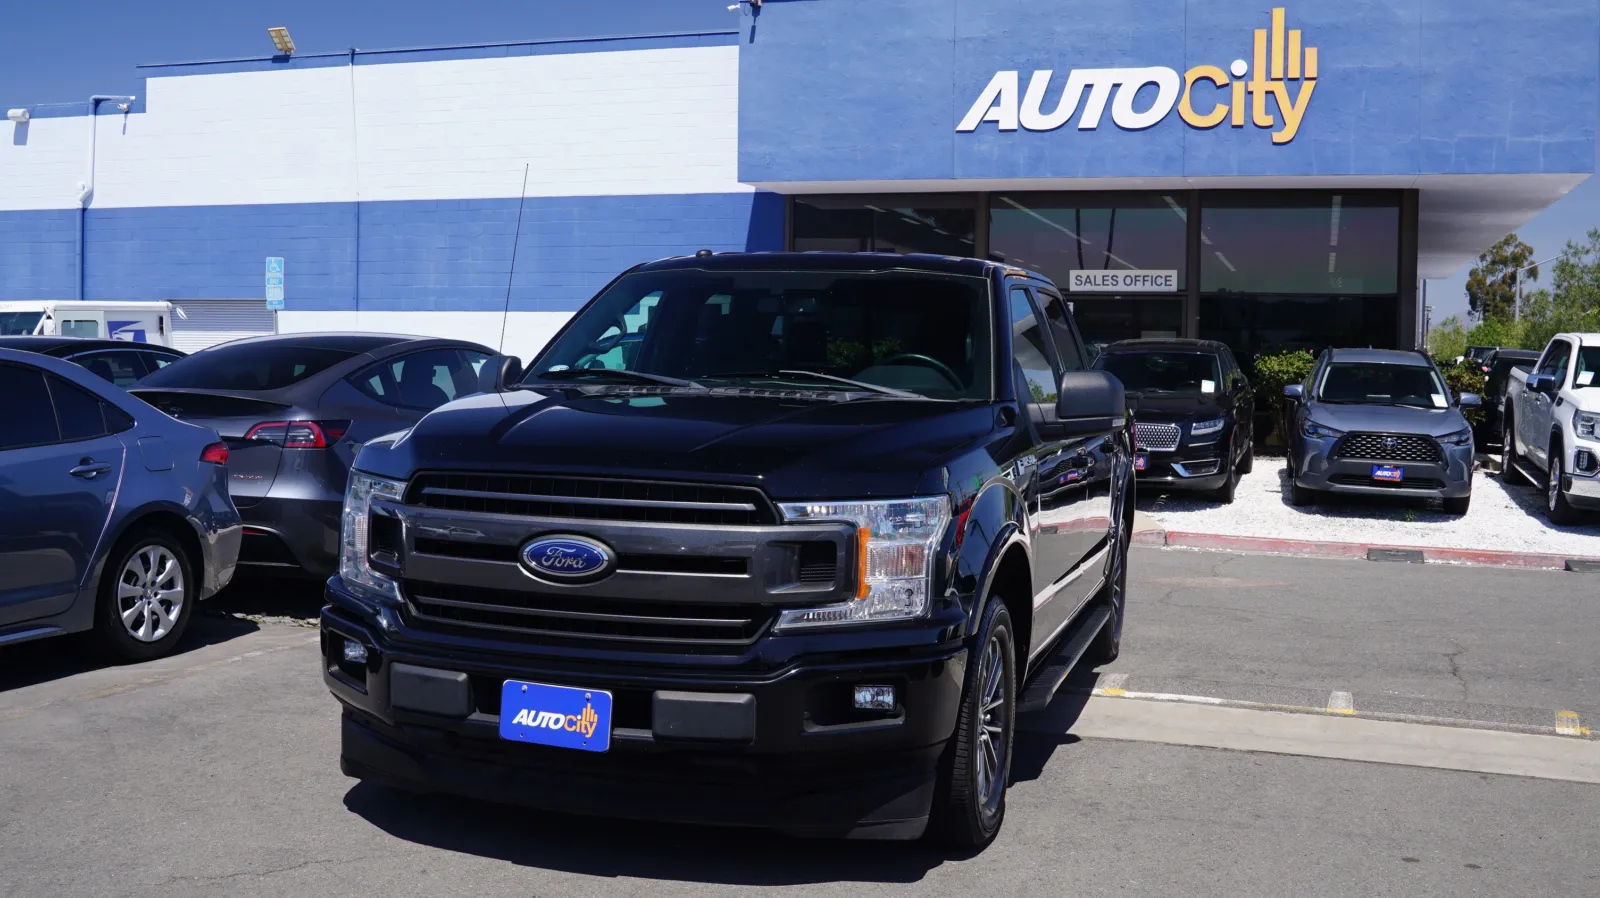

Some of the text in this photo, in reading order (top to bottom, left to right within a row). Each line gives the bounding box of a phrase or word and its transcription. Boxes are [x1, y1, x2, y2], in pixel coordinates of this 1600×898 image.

[1074, 274, 1173, 287] SALES OFFICE
[541, 546, 588, 569] Ford
